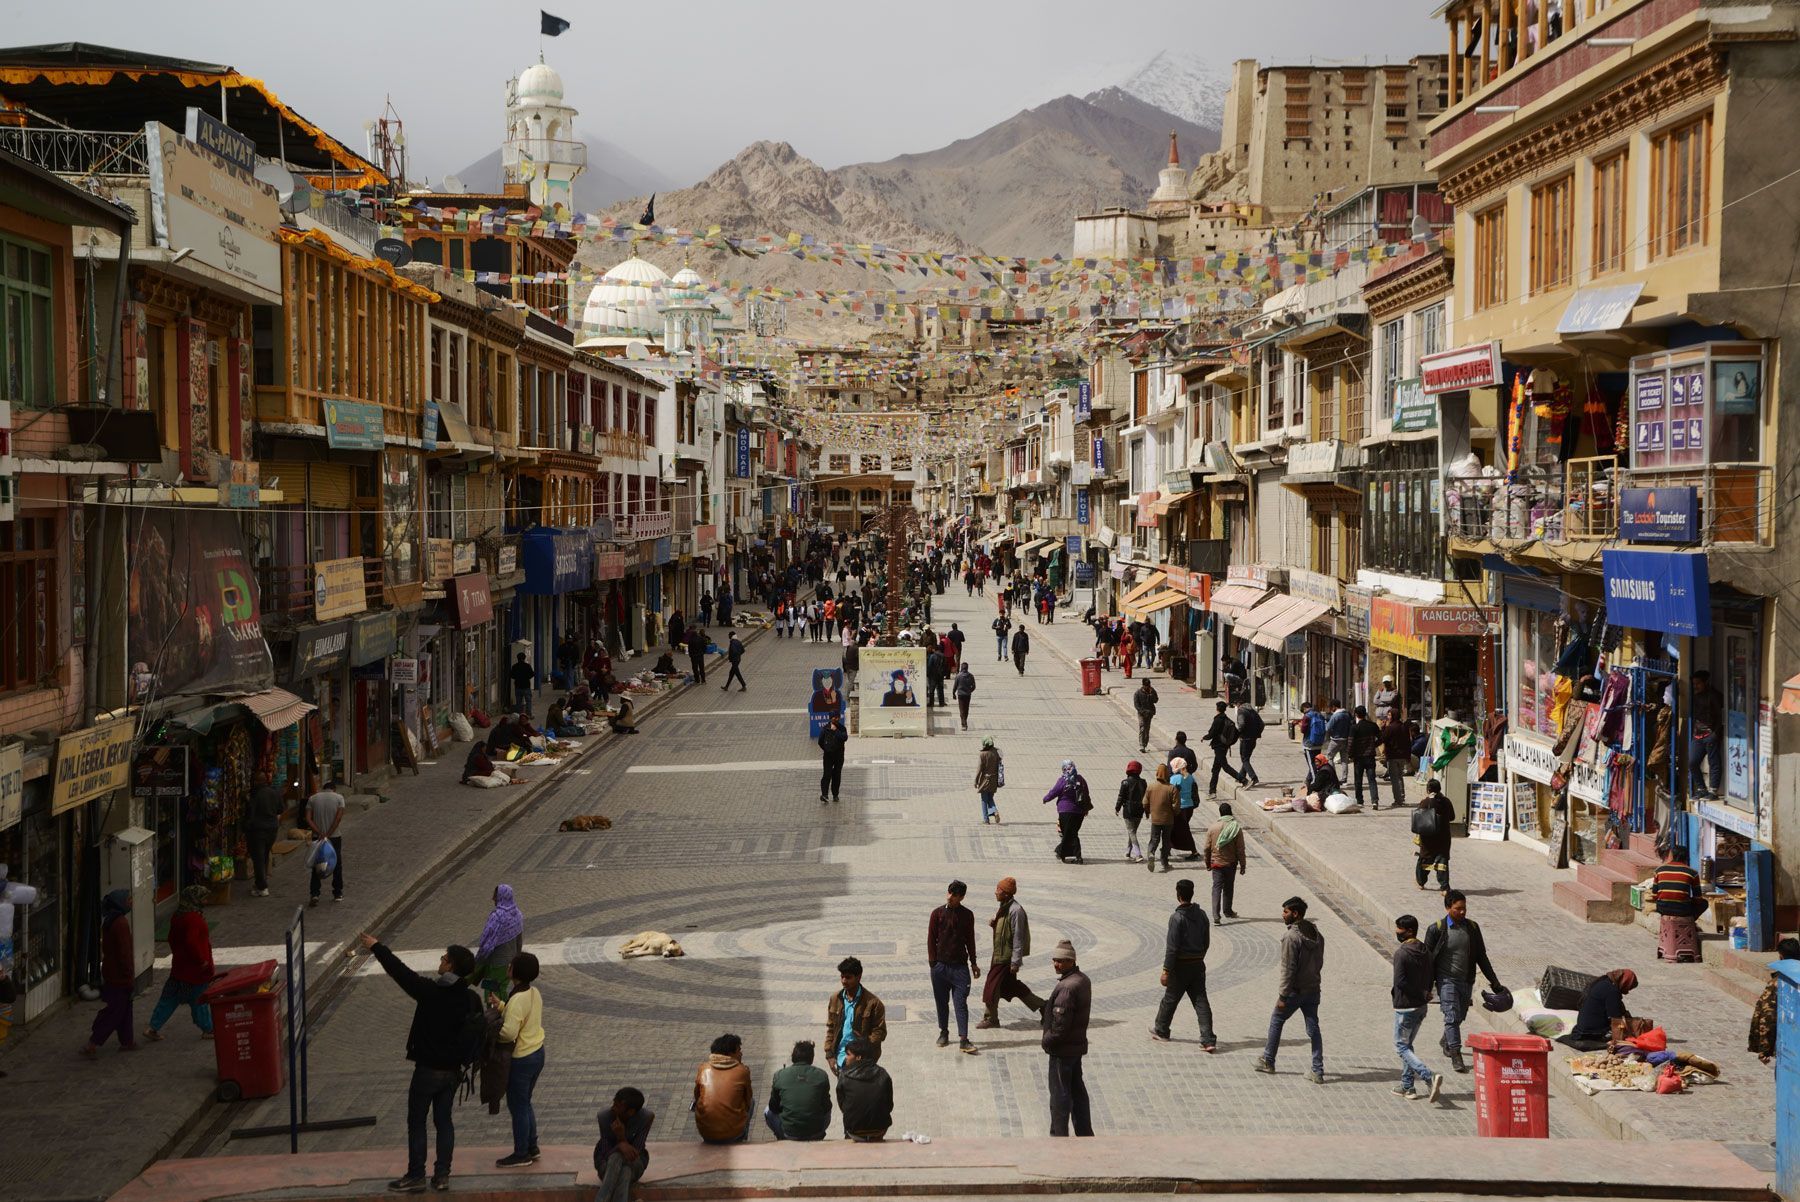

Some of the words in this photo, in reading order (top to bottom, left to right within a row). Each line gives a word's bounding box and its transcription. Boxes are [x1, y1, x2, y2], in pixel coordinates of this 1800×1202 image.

[201, 120, 254, 169] AL-HAYAT
[1624, 510, 1634, 524] The
[1656, 510, 1686, 526] Tourister
[1077, 561, 1093, 569] ATM
[472, 590, 487, 608] TITAN
[1610, 577, 1656, 602] SAMSUNG
[315, 632, 348, 659] HIMALAYAN
[1506, 736, 1541, 769] HIMALAYAN
